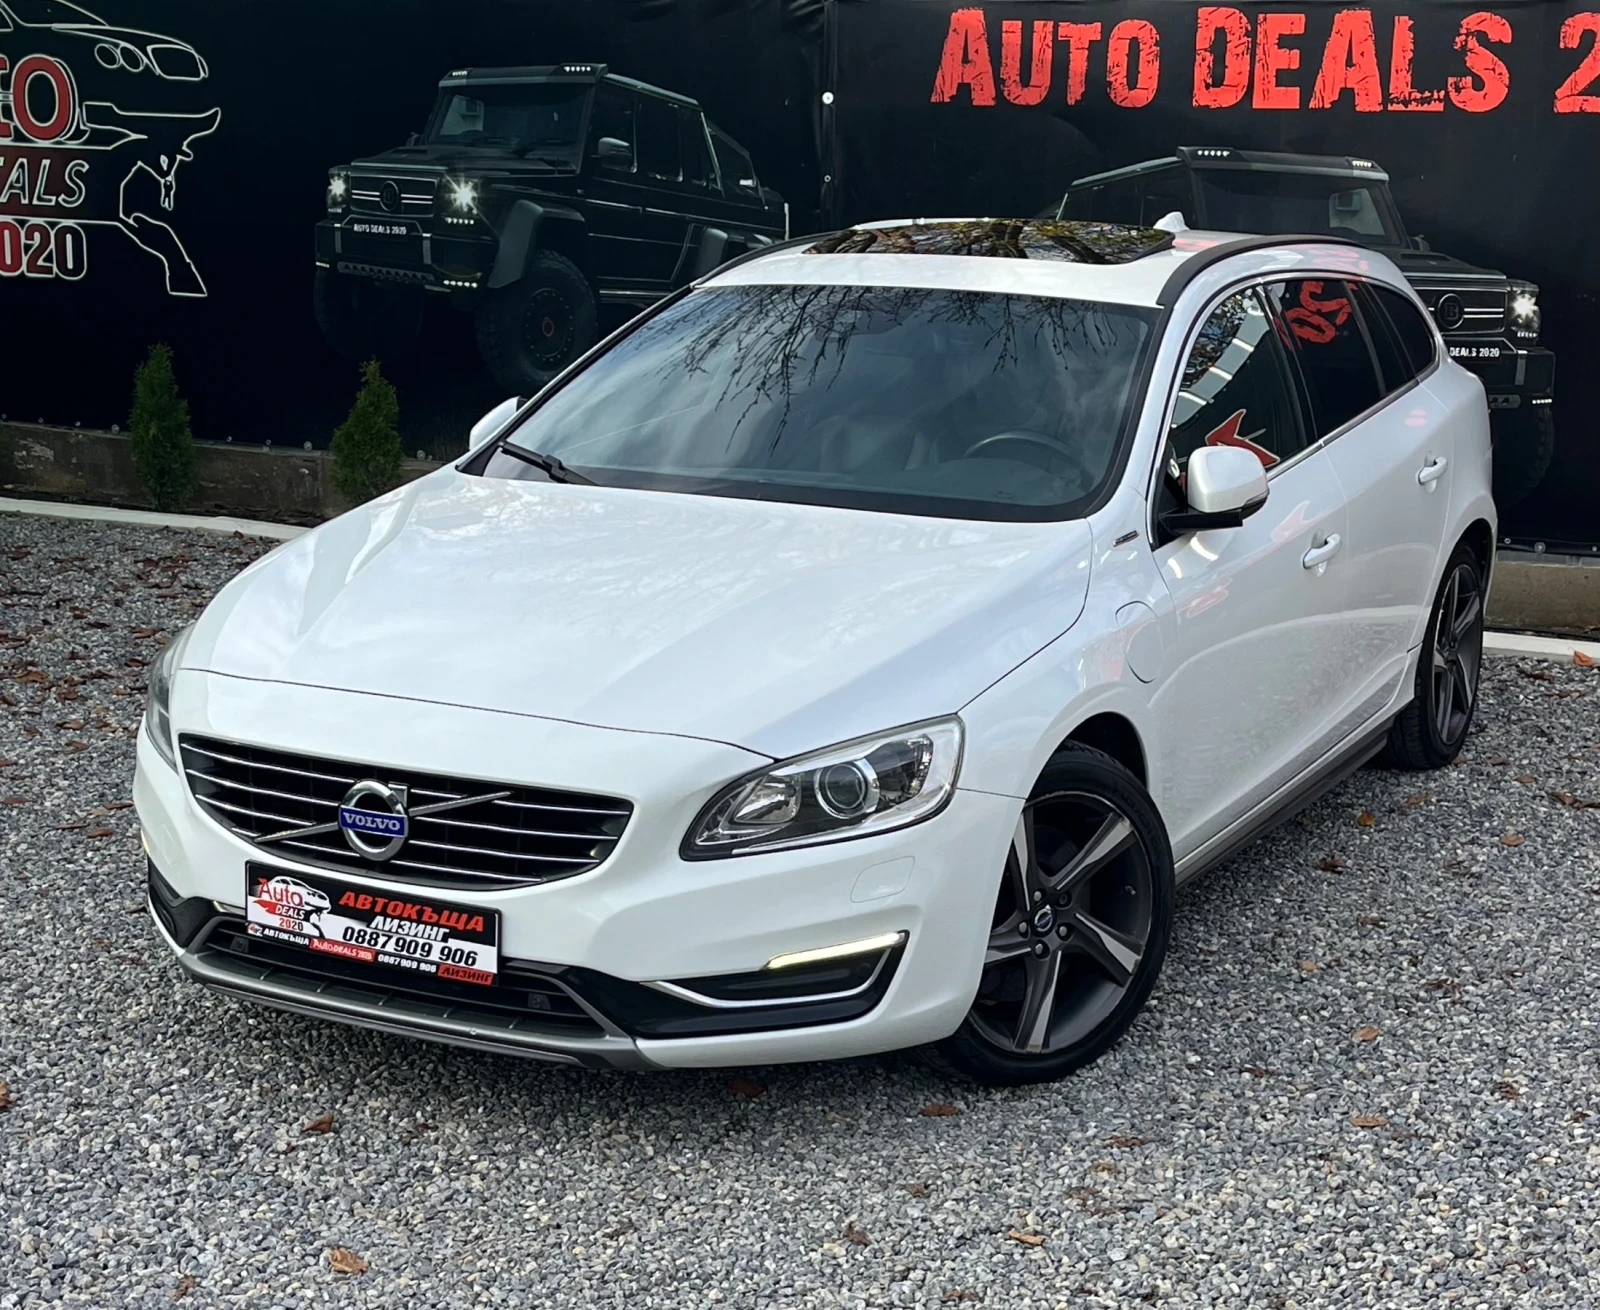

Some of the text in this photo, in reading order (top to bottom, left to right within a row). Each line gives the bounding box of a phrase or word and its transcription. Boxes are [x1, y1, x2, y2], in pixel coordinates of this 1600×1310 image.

[930, 8, 1162, 107] AUTO
[1192, 6, 1511, 113] DEALS
[370, 224, 390, 234] DEALS
[1449, 346, 1500, 357] DEALS 2020
[343, 812, 401, 831] VOLVO
[259, 879, 304, 907] Auto
[275, 905, 306, 919] DEALS
[338, 891, 484, 932] АВТОКЪЩА
[279, 917, 304, 932] 2020
[369, 915, 450, 941] ЛИЗИНГ
[342, 926, 479, 967] 0887 909 906
[377, 954, 437, 973] 0887 909 906
[441, 965, 492, 984] ЛИЗИНГ
